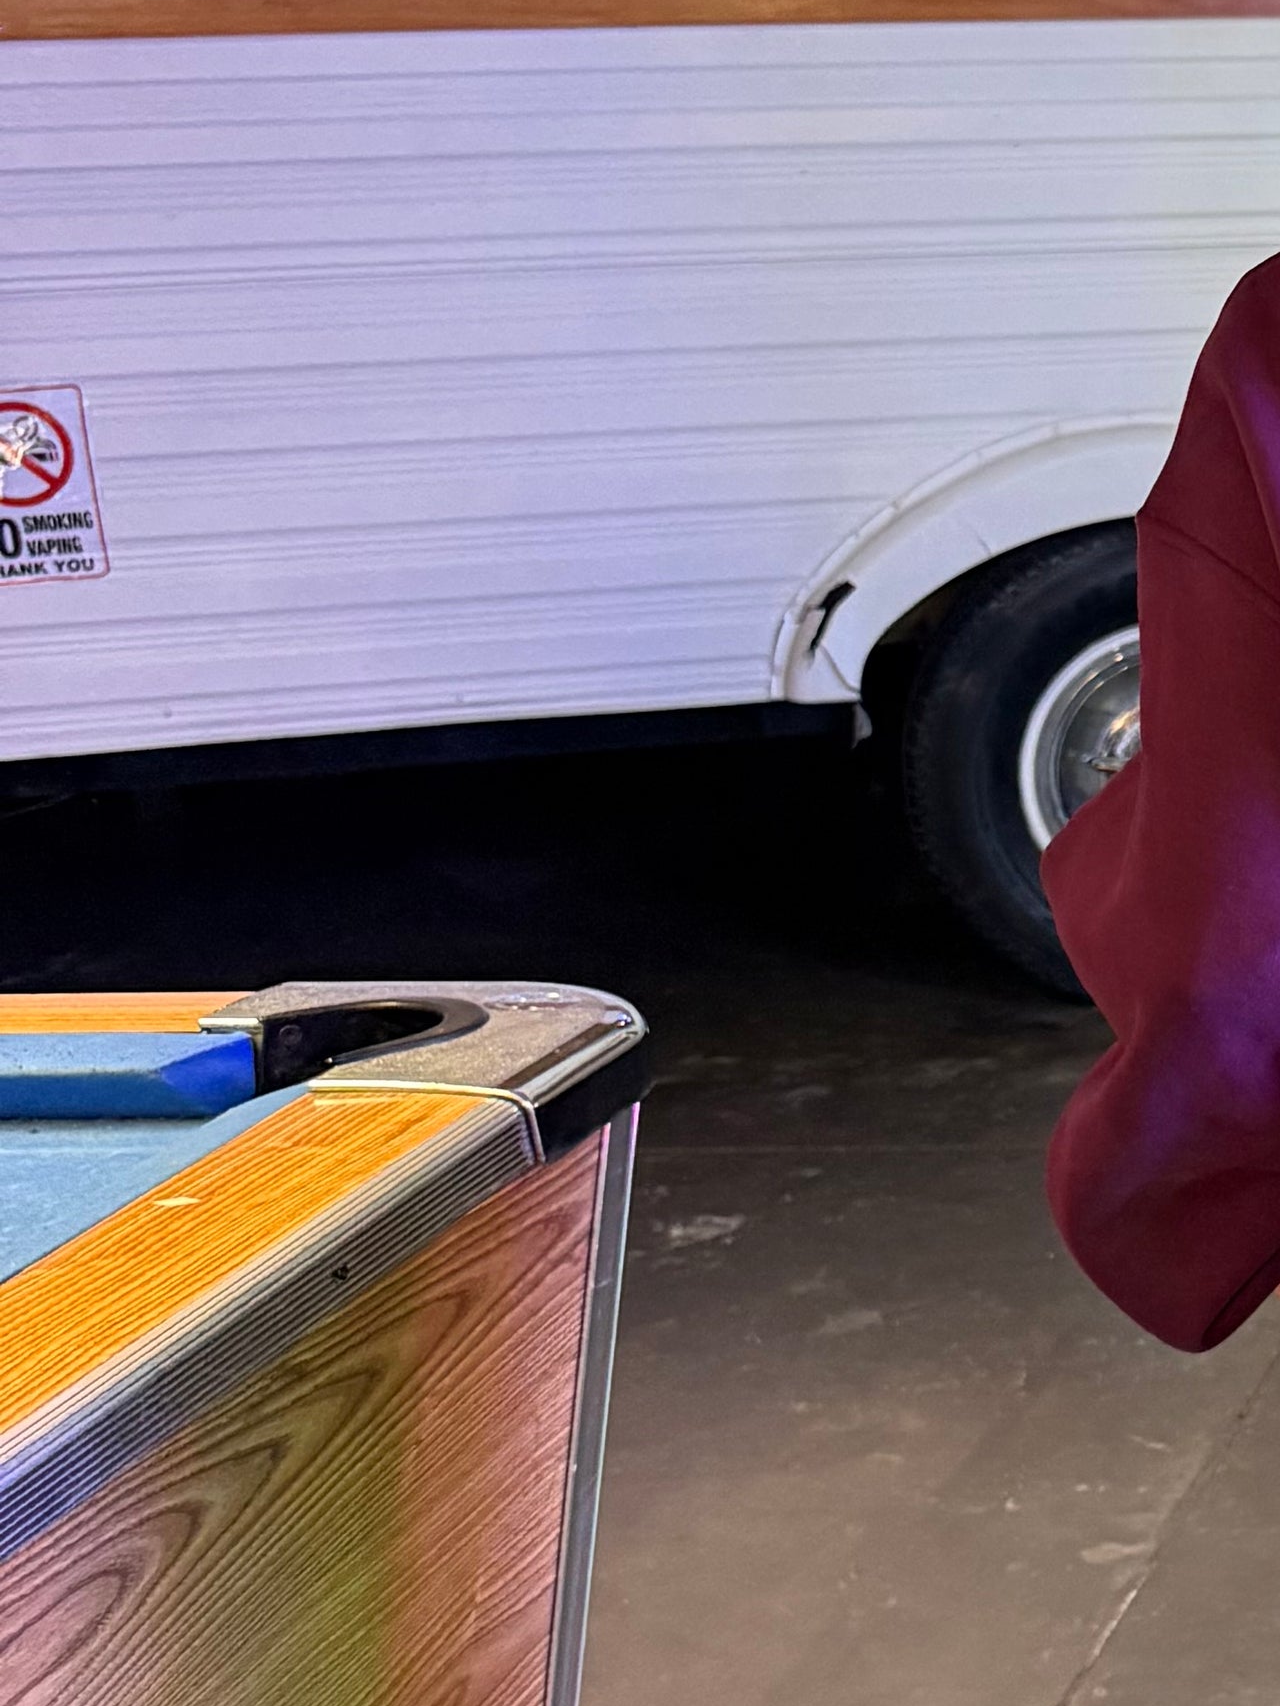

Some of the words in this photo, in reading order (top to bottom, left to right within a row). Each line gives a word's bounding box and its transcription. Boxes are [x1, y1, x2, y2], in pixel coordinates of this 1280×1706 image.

[22, 510, 94, 534] SMOKING
[26, 536, 83, 557] VAPING
[54, 557, 95, 573] YOU
